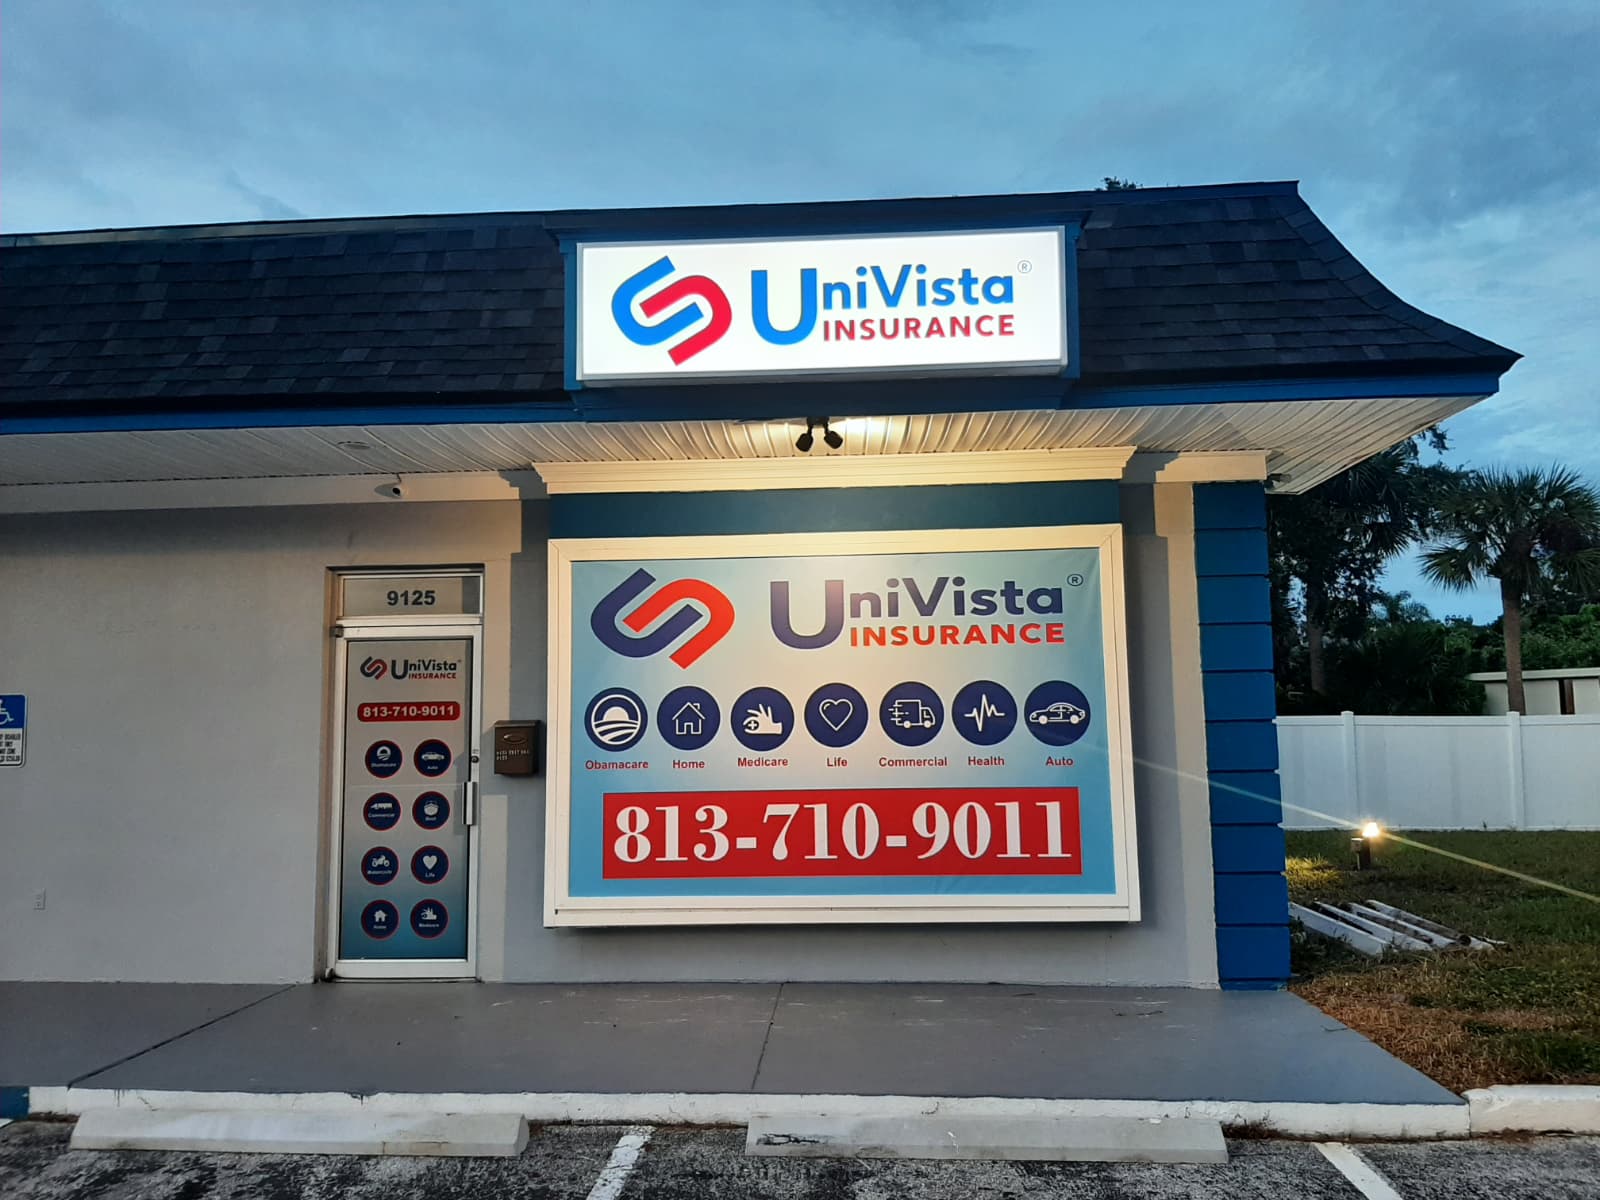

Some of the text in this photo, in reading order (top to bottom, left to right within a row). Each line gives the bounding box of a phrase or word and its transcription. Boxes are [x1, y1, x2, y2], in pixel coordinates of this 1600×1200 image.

[750, 263, 1015, 345] UniVista
[822, 314, 1015, 342] INSURANCE
[386, 589, 436, 606] 9125
[769, 576, 1064, 650] UniVista
[849, 622, 1065, 648] INSURANCE
[390, 659, 457, 680] UniVista
[408, 672, 457, 680] INSURANCE
[362, 705, 455, 718] 813-710-9011
[585, 759, 649, 770] Obamacare
[672, 759, 705, 769] Home
[737, 757, 789, 767] Medicare
[826, 757, 848, 767] Life
[878, 756, 948, 767] Commercial
[967, 756, 1005, 766] Health
[1045, 756, 1074, 766] Auto
[613, 800, 1072, 863] 813-710-9011
